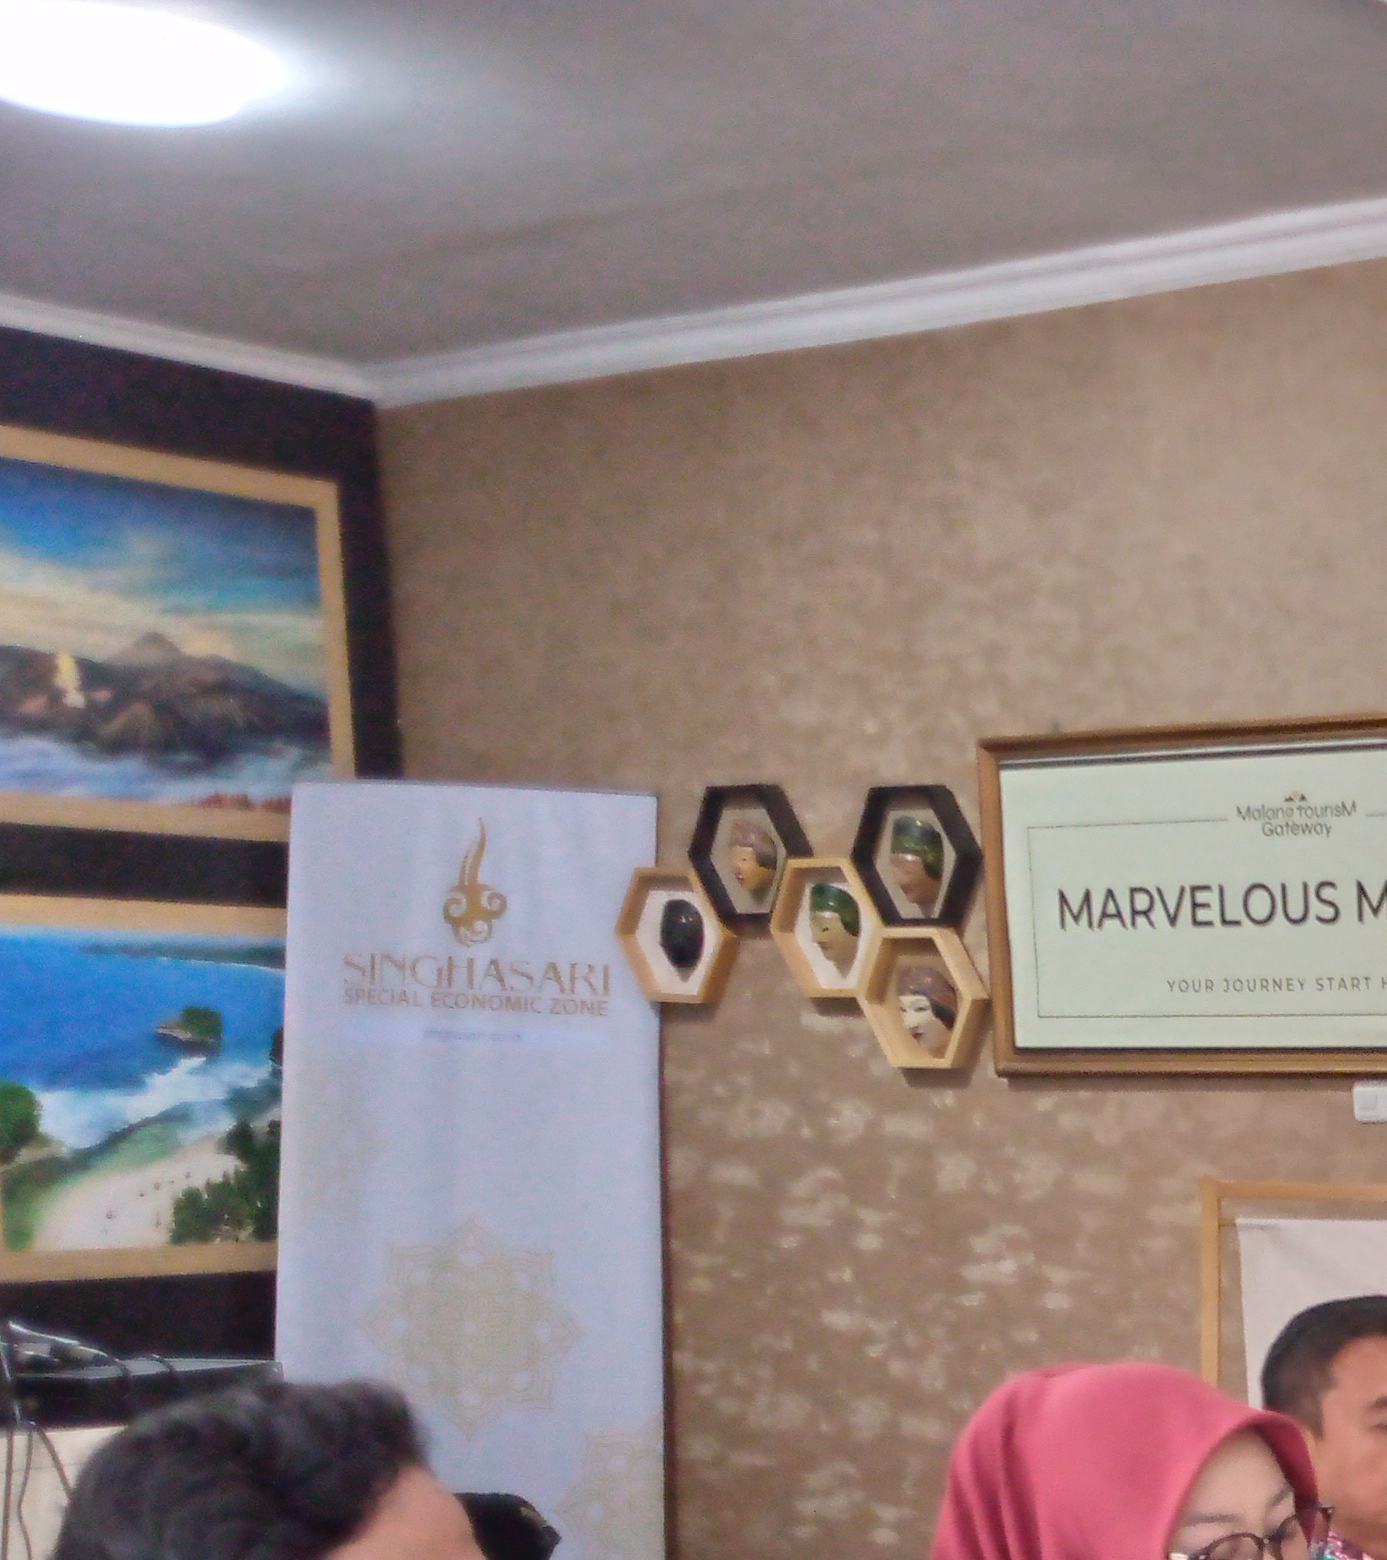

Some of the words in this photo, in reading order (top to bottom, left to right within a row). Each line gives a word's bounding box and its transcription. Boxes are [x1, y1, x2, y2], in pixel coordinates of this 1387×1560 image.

[1261, 820, 1332, 838] Gateway
[1056, 880, 1341, 932] MARVELOUS
[343, 952, 611, 996] SINGHASARI
[1167, 978, 1215, 993] YOUR
[1222, 977, 1306, 993] JOURNEY
[1316, 975, 1371, 992] START
[344, 988, 423, 1007] SPECIAL
[430, 991, 542, 1014] ECONOMIC
[549, 998, 609, 1016] ZONE
